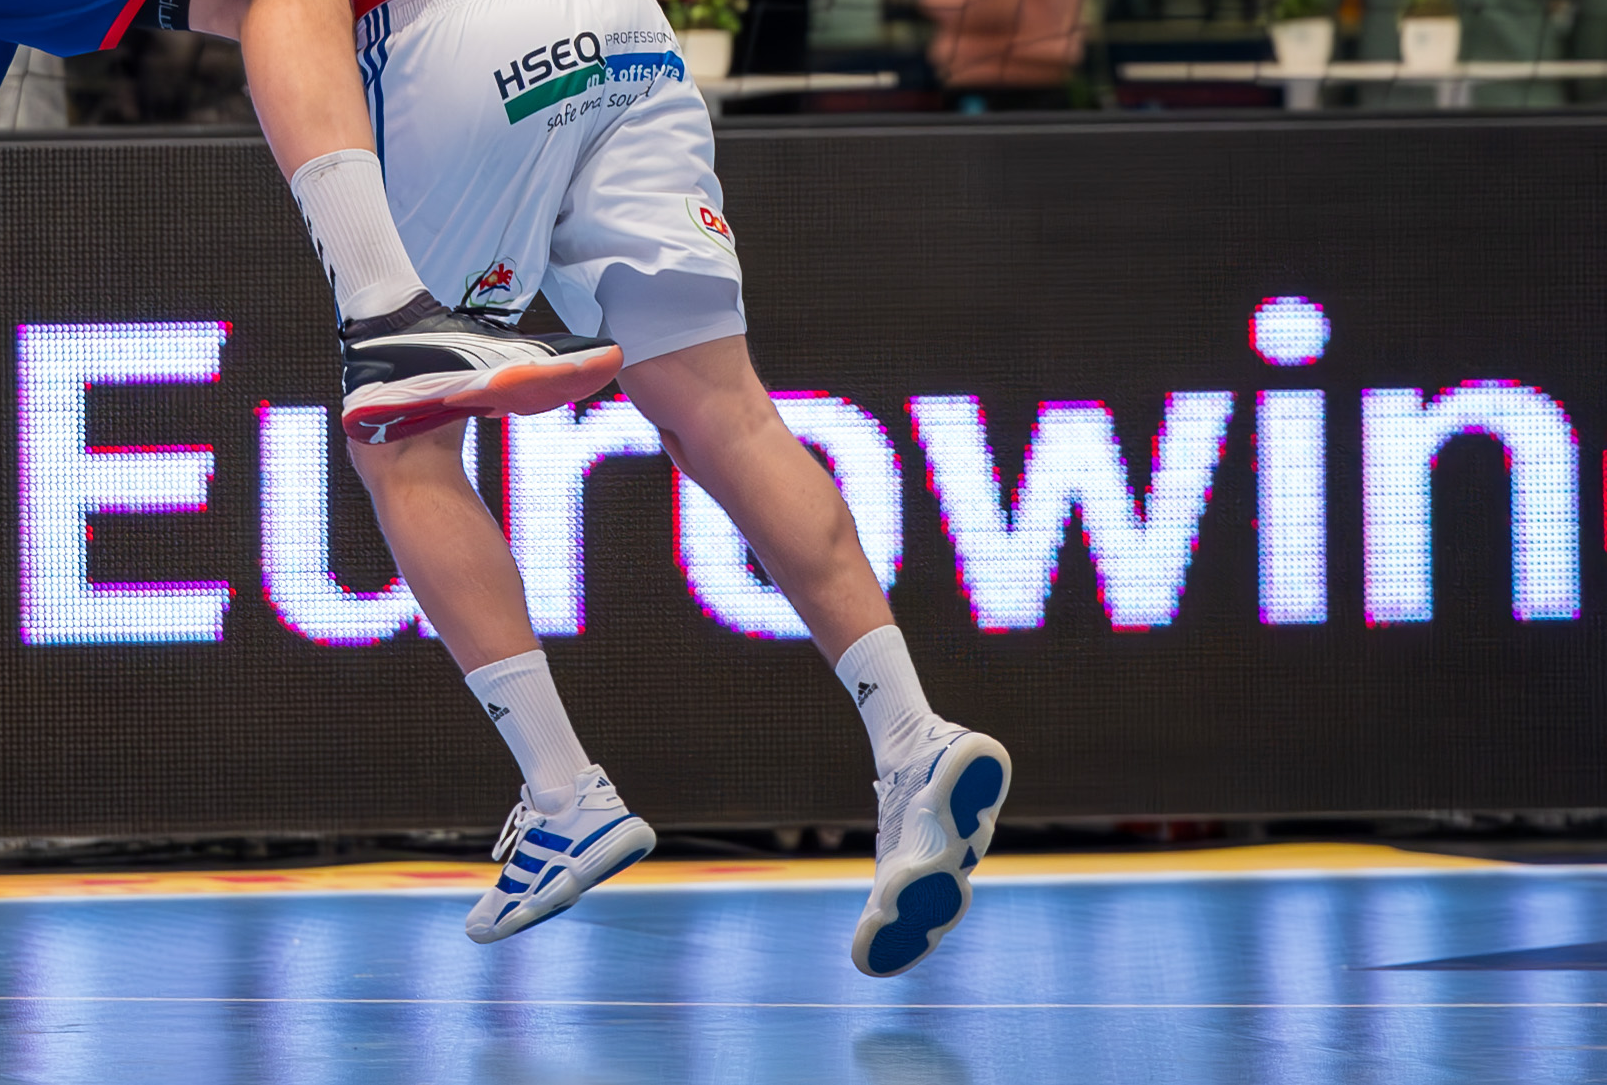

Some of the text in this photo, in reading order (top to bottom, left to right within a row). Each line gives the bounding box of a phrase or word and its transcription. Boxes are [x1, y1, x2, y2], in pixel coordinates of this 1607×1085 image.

[493, 31, 608, 101] HSEQ
[547, 103, 577, 133] safe
[16, 295, 1607, 649] Eurowin
